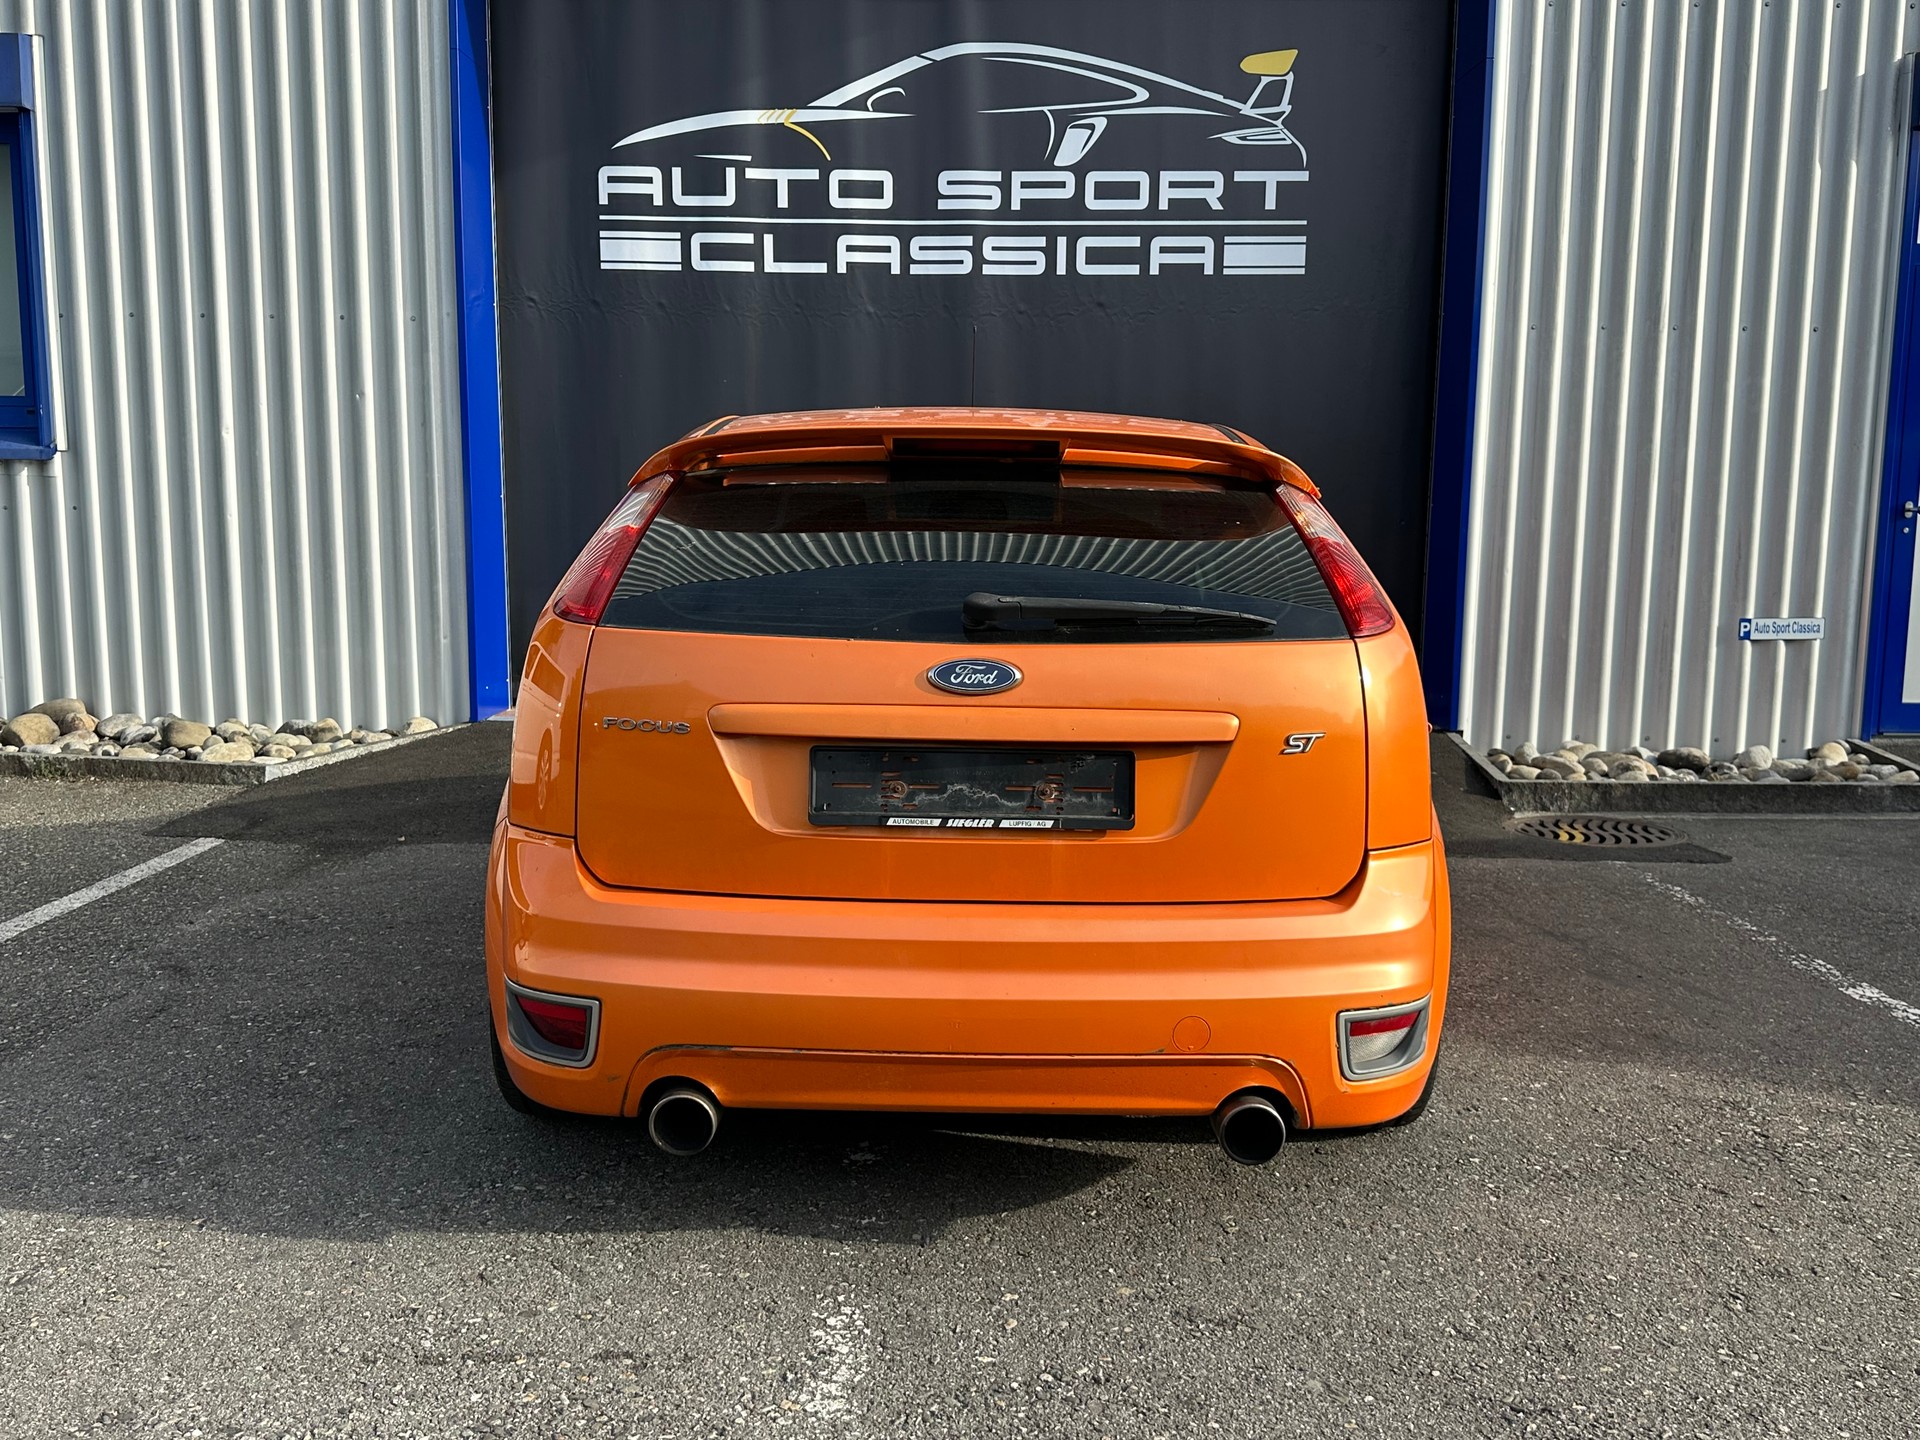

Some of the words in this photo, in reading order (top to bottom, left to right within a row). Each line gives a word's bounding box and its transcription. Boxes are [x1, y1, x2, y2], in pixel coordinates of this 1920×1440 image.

[598, 165, 894, 210] AUTO
[937, 170, 1310, 211] SPORT
[690, 232, 1215, 276] CLASSICA
[1740, 622, 1751, 637] P
[1754, 621, 1770, 634] Auto
[1771, 621, 1791, 636] Sport
[1792, 621, 1821, 634] Classica
[950, 664, 998, 684] Ford
[603, 716, 690, 734] FOCUS
[1282, 732, 1326, 754] ST
[892, 818, 934, 826] AUTOMOBILE
[946, 818, 995, 828] SIEGLER
